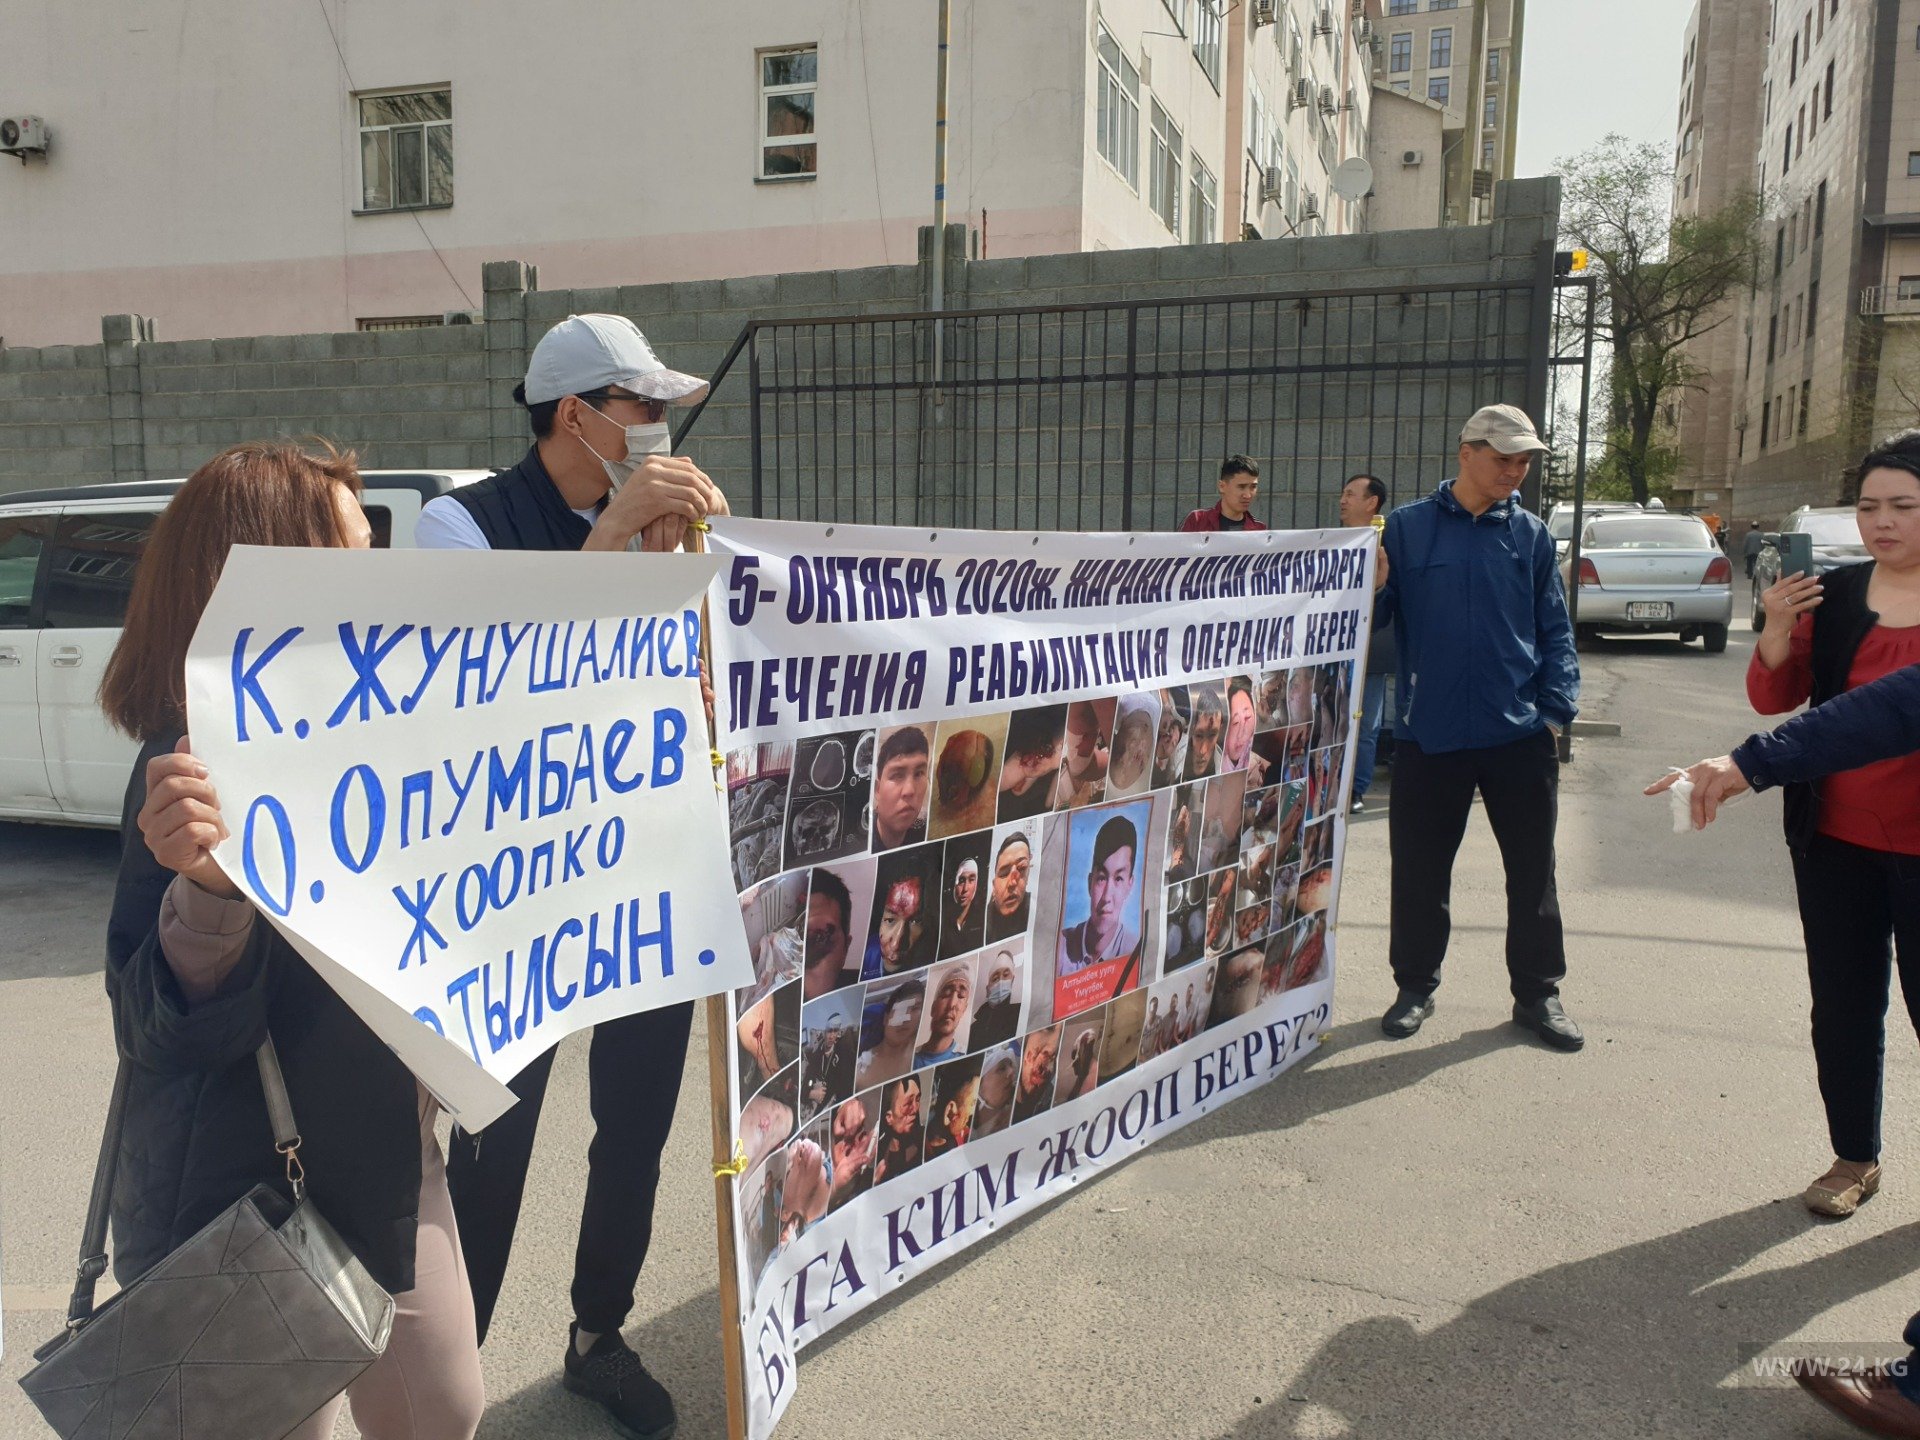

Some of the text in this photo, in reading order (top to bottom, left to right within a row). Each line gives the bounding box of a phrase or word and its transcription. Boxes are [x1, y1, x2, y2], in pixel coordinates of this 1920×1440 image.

[729, 555, 777, 626] 5-
[787, 554, 948, 625] ОКТЯБРЬ
[1063, 556, 1189, 609] ЖАРАКАТ
[1179, 554, 1255, 601] АЛГАН
[1251, 548, 1366, 599] ЖАРАНДАРГА
[729, 609, 1360, 733] ЛЕЧЕНИЯ РЕАБИЛИТАЦИЯ ОПЕРАЦИЯ КЕРЕК
[757, 1002, 1329, 1420] БУГА КИМ ЖООП БЕРЕТ?
